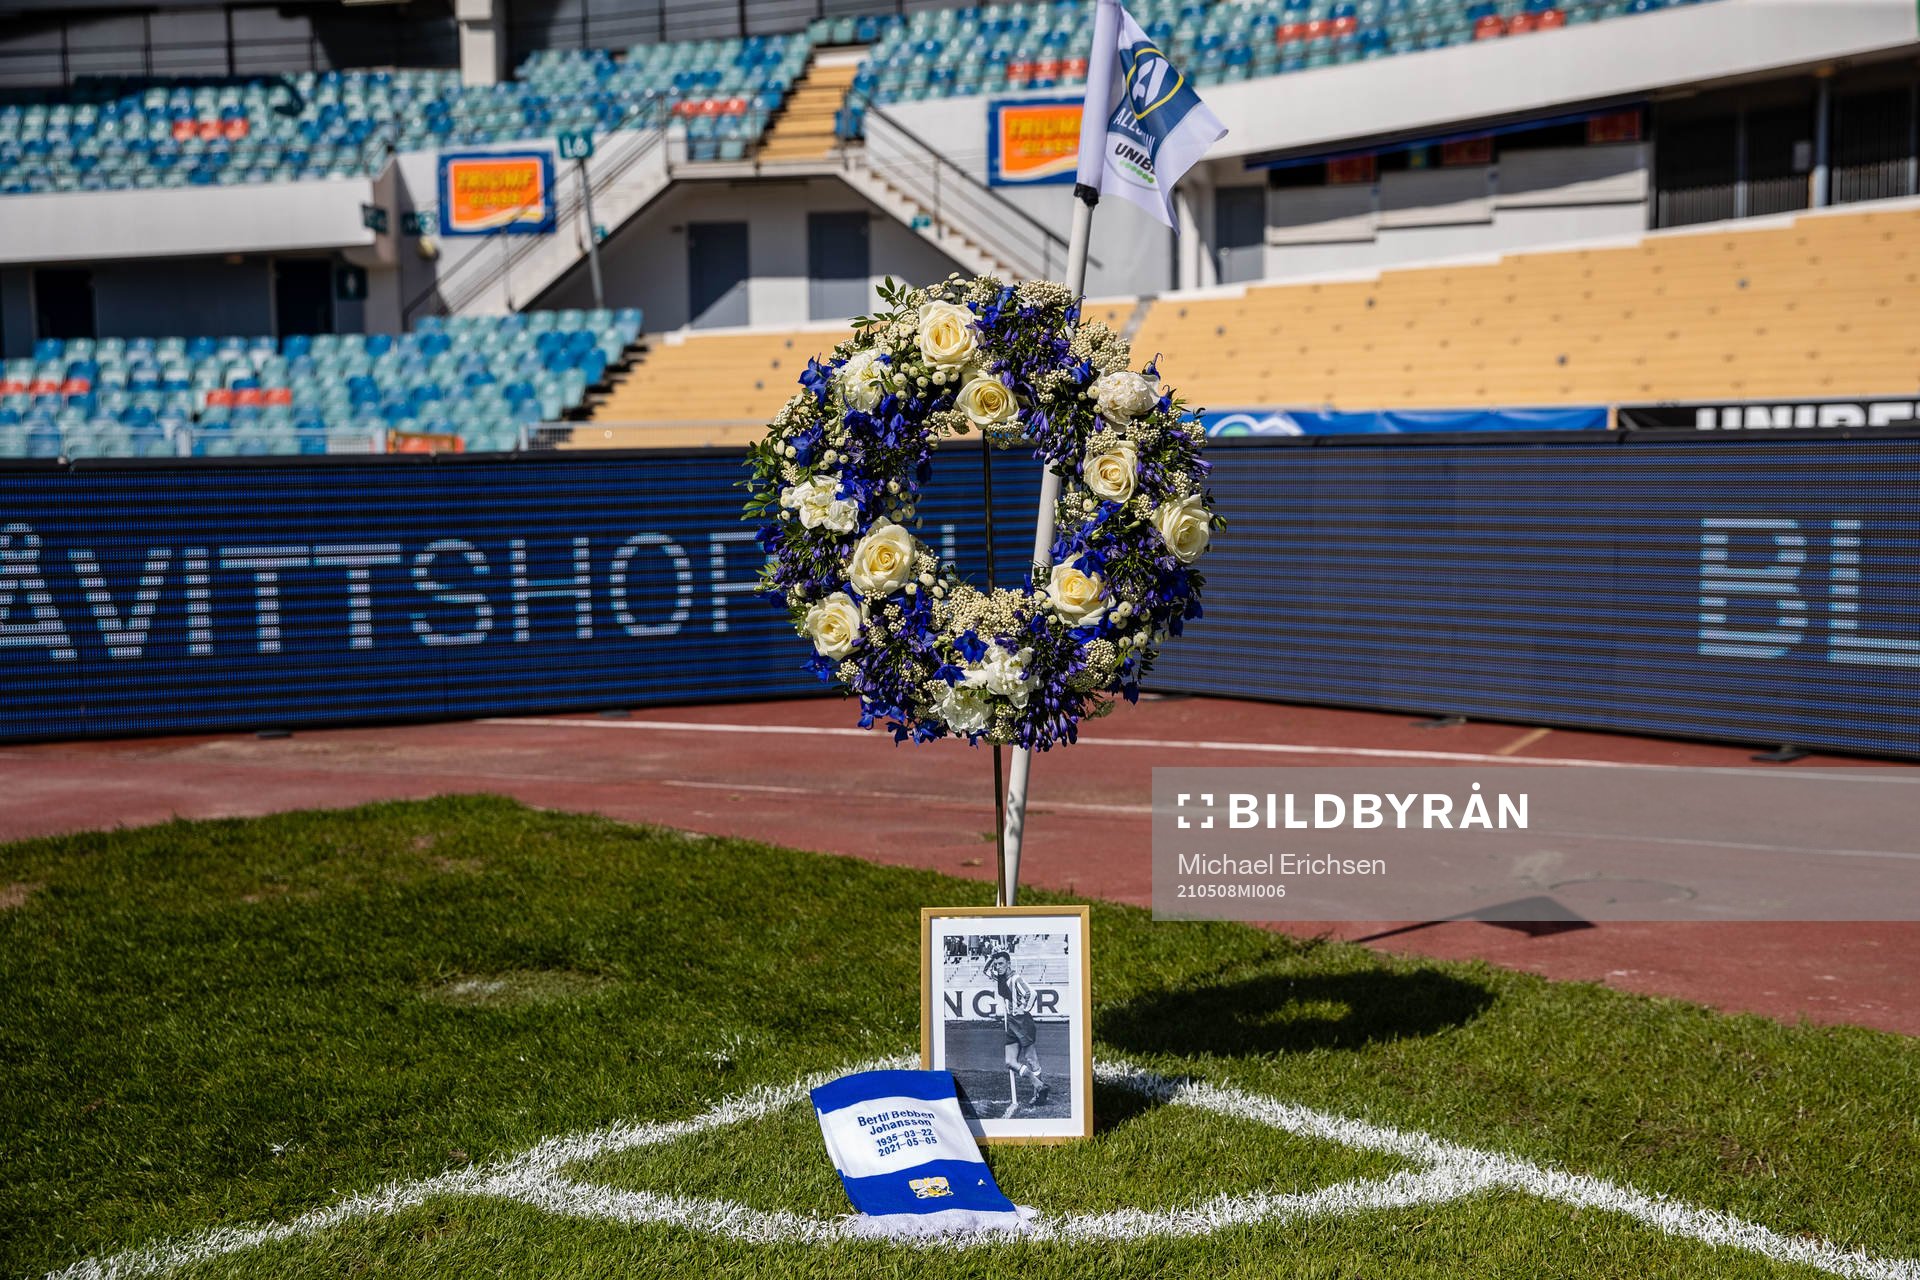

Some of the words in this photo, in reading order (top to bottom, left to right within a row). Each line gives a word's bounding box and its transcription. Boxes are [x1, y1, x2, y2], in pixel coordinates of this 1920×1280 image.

[1698, 517, 1920, 667] BL
[944, 989, 1060, 1018] NGR
[857, 1112, 890, 1127] Bertil
[891, 1109, 935, 1120] Bebben
[870, 1119, 932, 1135] Johansson
[876, 1128, 933, 1147] 1935-03-22
[878, 1136, 937, 1157] 2021-05-05
